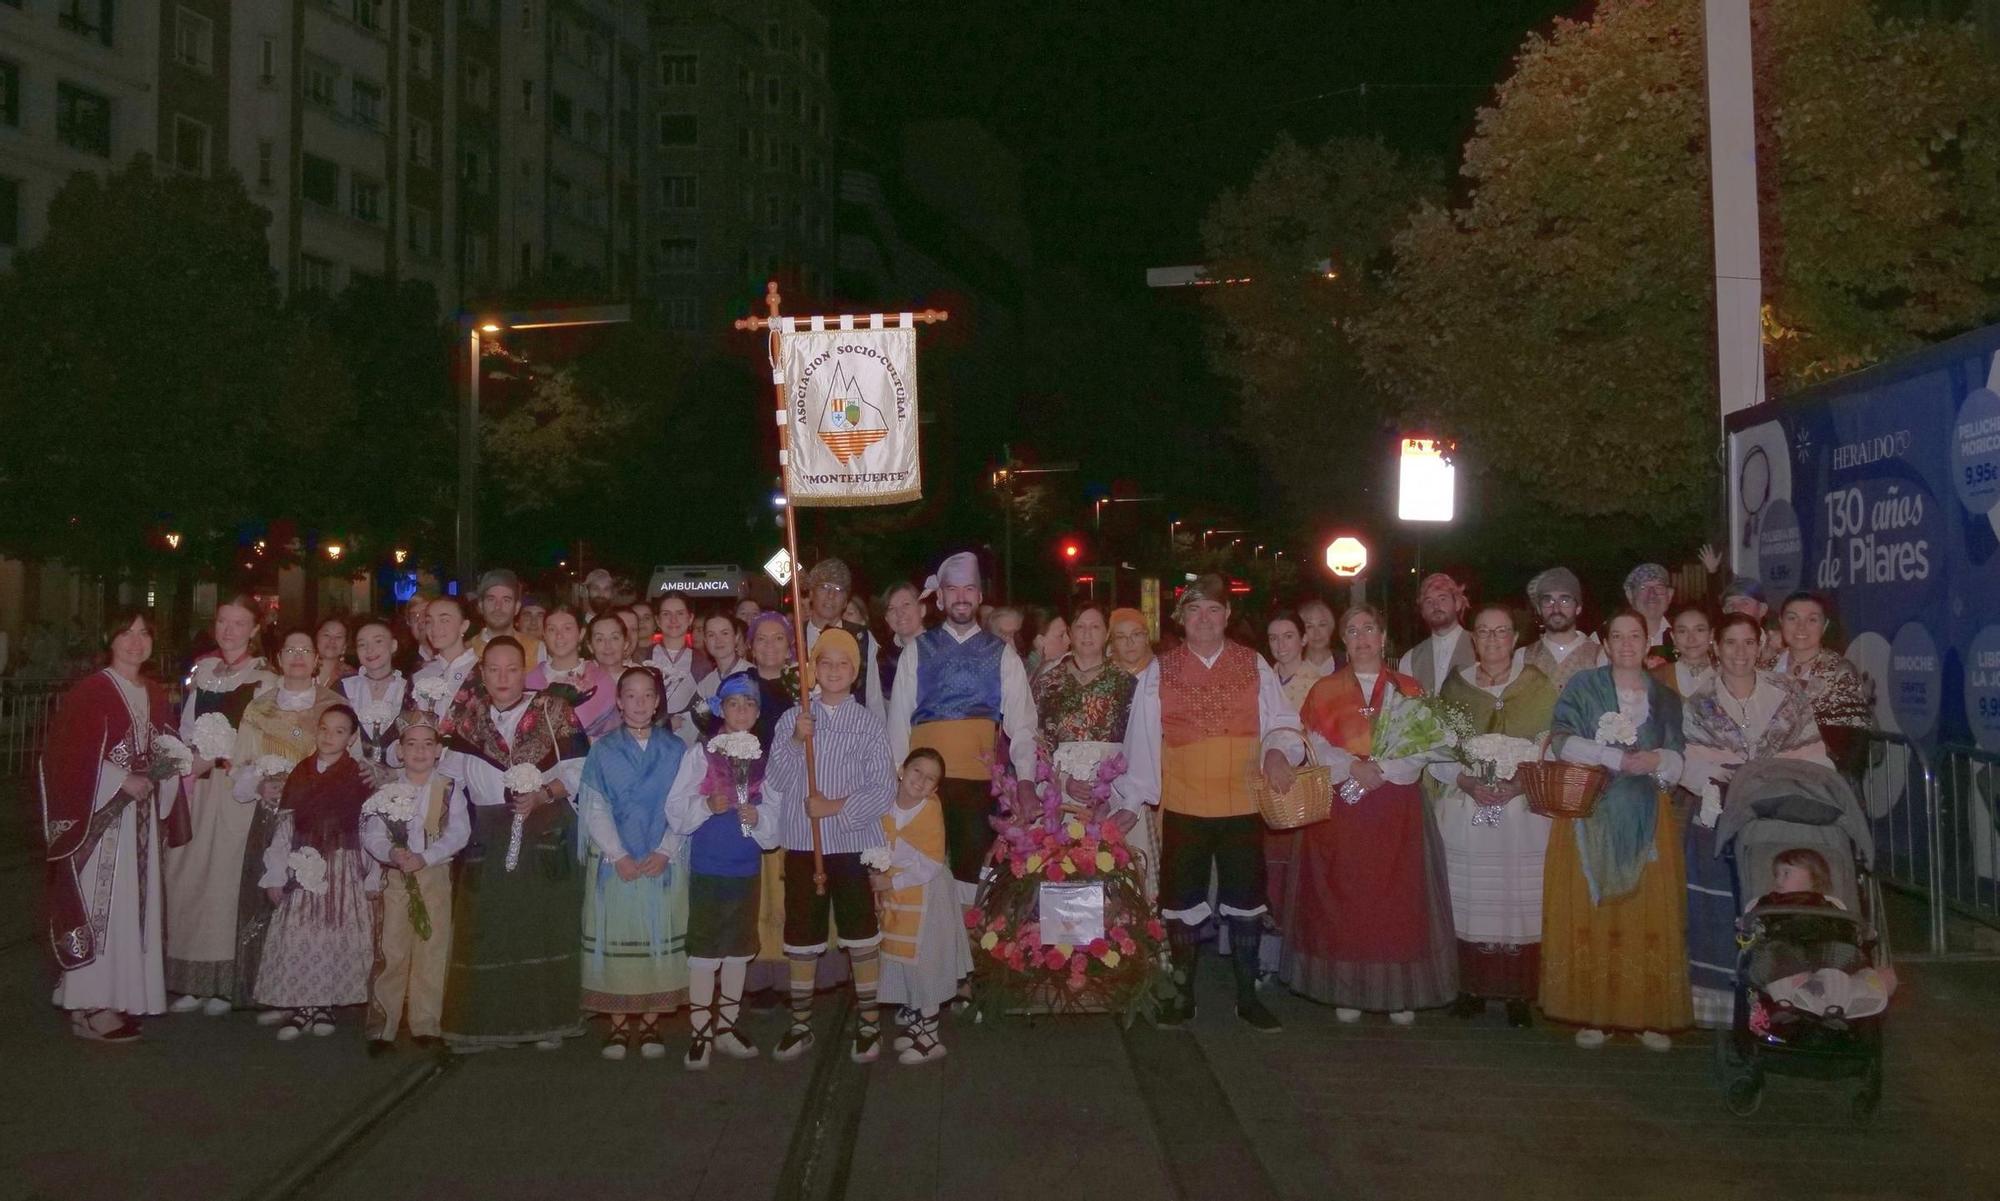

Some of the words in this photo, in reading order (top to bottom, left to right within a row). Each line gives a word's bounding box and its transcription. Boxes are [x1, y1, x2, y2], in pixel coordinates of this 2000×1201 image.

[797, 350, 831, 424] ASOCIACION
[836, 345, 907, 422] SOCIO-CULTURAL
[1833, 434, 1895, 470] HERALDO
[803, 470, 909, 484] "MONTEFUERTE"
[1824, 487, 1864, 538] 130
[1871, 485, 1923, 530] años
[775, 560, 791, 573] 30
[1817, 540, 1843, 589] de
[1850, 533, 1929, 585] Pilares
[660, 581, 729, 591] AMBULANCIA
[1894, 655, 1935, 672] BROCHE
[1971, 671, 1987, 687] LA
[1979, 696, 2000, 719] 9,9
